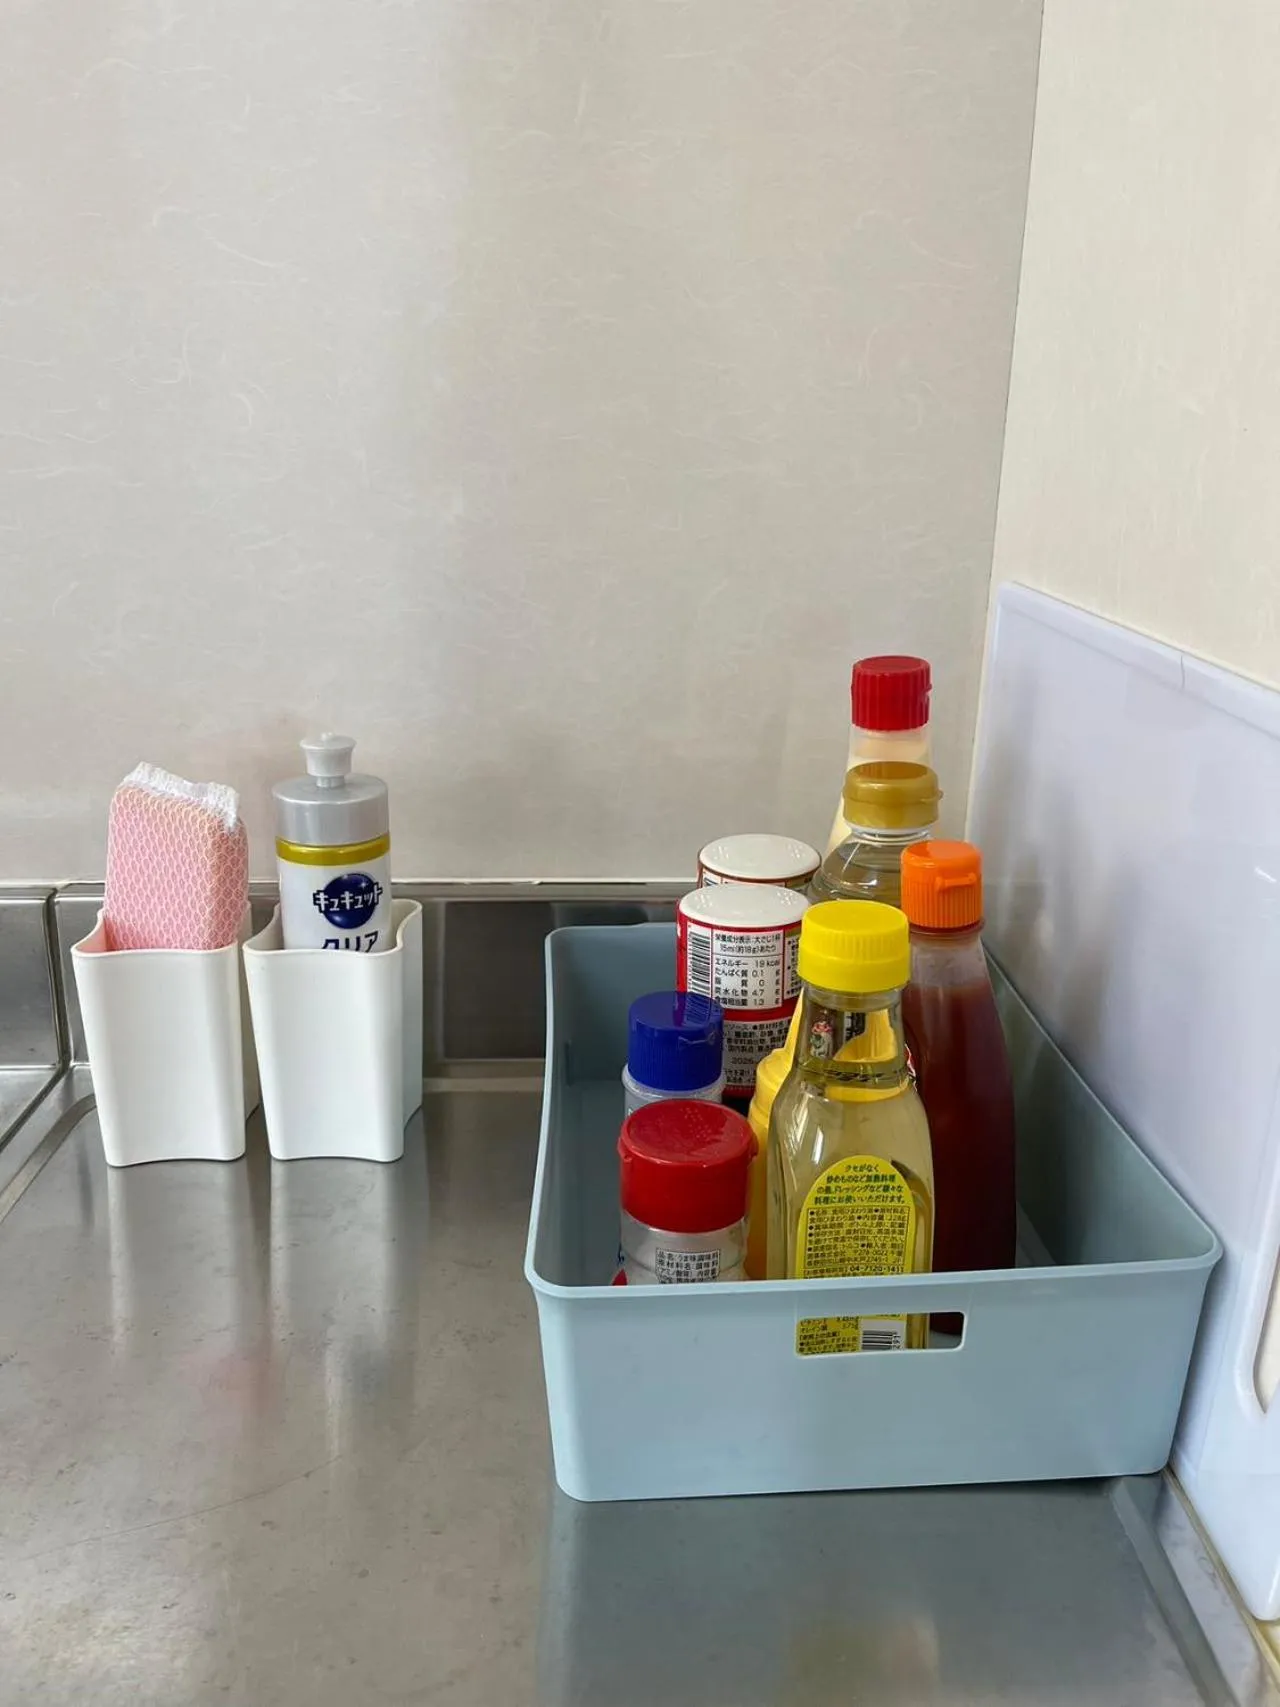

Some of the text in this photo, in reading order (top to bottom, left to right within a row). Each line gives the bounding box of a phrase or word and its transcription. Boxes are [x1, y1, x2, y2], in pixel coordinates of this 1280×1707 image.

[313, 883, 383, 914] キュキュット
[715, 958, 749, 968] エネルギー
[715, 968, 748, 979] たんぱく質
[715, 986, 748, 997] 炭水化物
[845, 1164, 881, 1173] クセがなく
